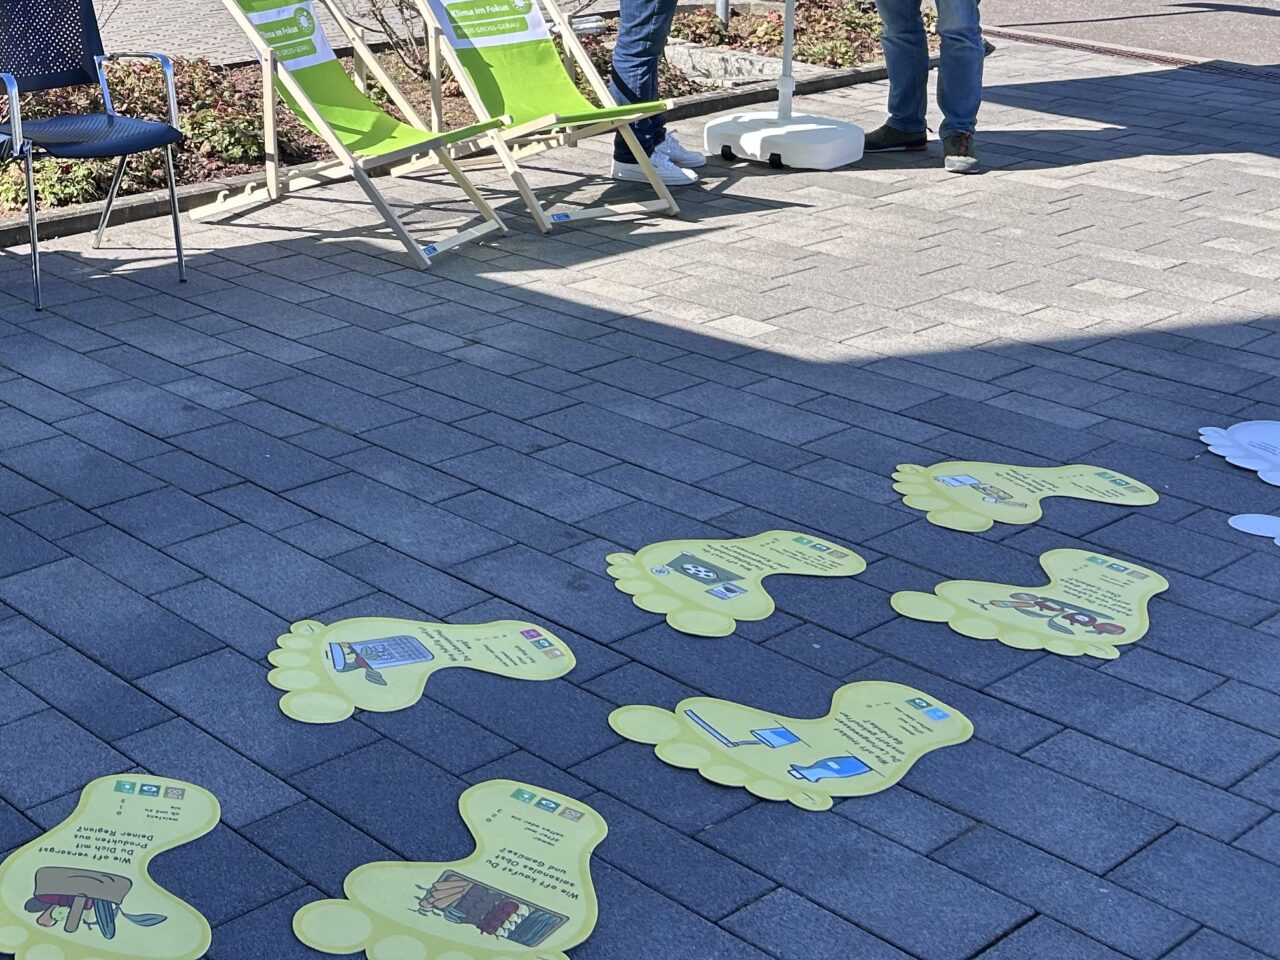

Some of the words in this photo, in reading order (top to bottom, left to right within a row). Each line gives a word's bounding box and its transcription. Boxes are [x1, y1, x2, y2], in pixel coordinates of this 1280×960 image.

[76, 826, 117, 837] Region?
[121, 831, 154, 841] Deiner
[95, 837, 148, 849] Produkten
[39, 846, 88, 857] versorgst
[95, 845, 117, 854] Dich
[113, 856, 131, 864] Wie
[495, 854, 519, 866] Obst
[499, 848, 545, 867] Gemüse?
[486, 859, 500, 868] Du
[502, 866, 537, 883] kaufst
[547, 865, 567, 874] und
[523, 864, 575, 887] saisonales
[540, 881, 557, 890] oft
[561, 889, 578, 900] Wie
